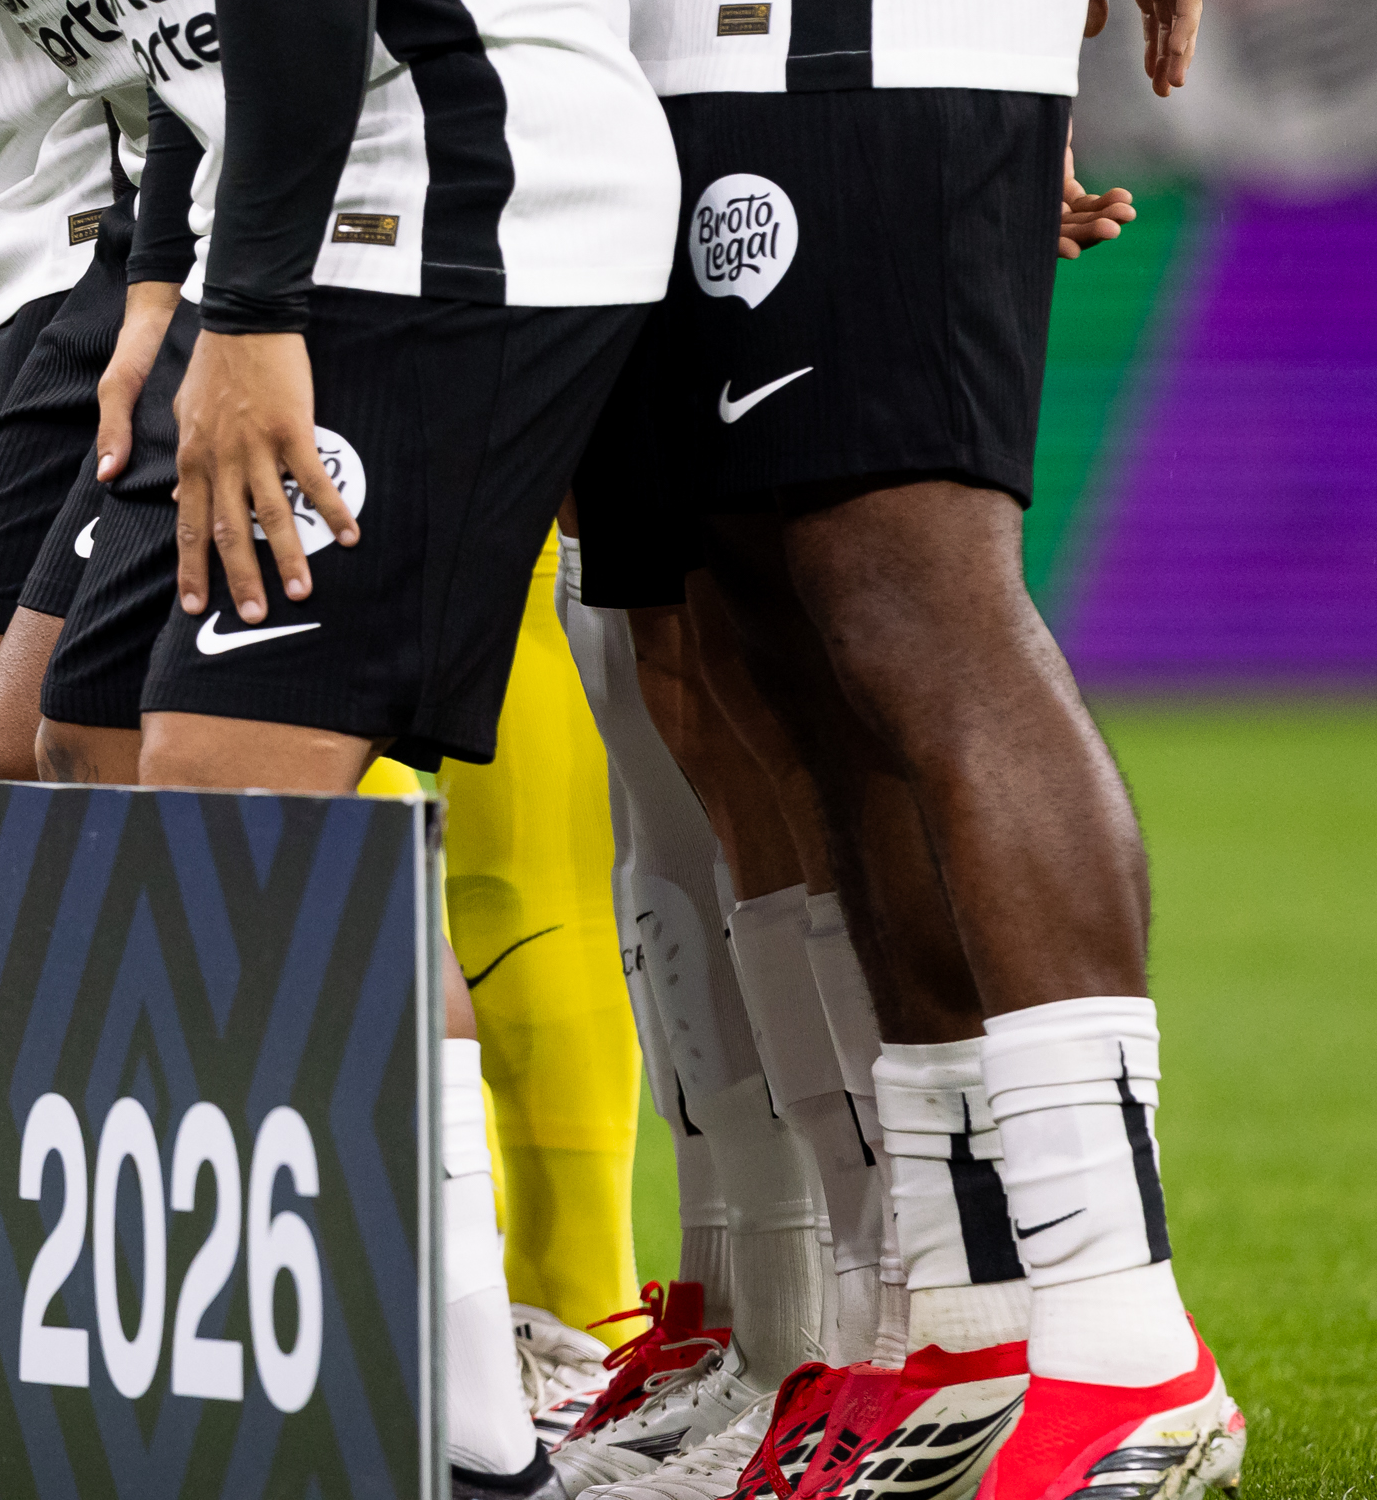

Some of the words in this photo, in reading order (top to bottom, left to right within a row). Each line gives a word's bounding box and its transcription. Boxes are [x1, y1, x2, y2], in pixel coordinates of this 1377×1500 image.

[697, 192, 773, 245] Broto
[706, 222, 780, 282] Legal
[20, 1092, 324, 1413] 2026
